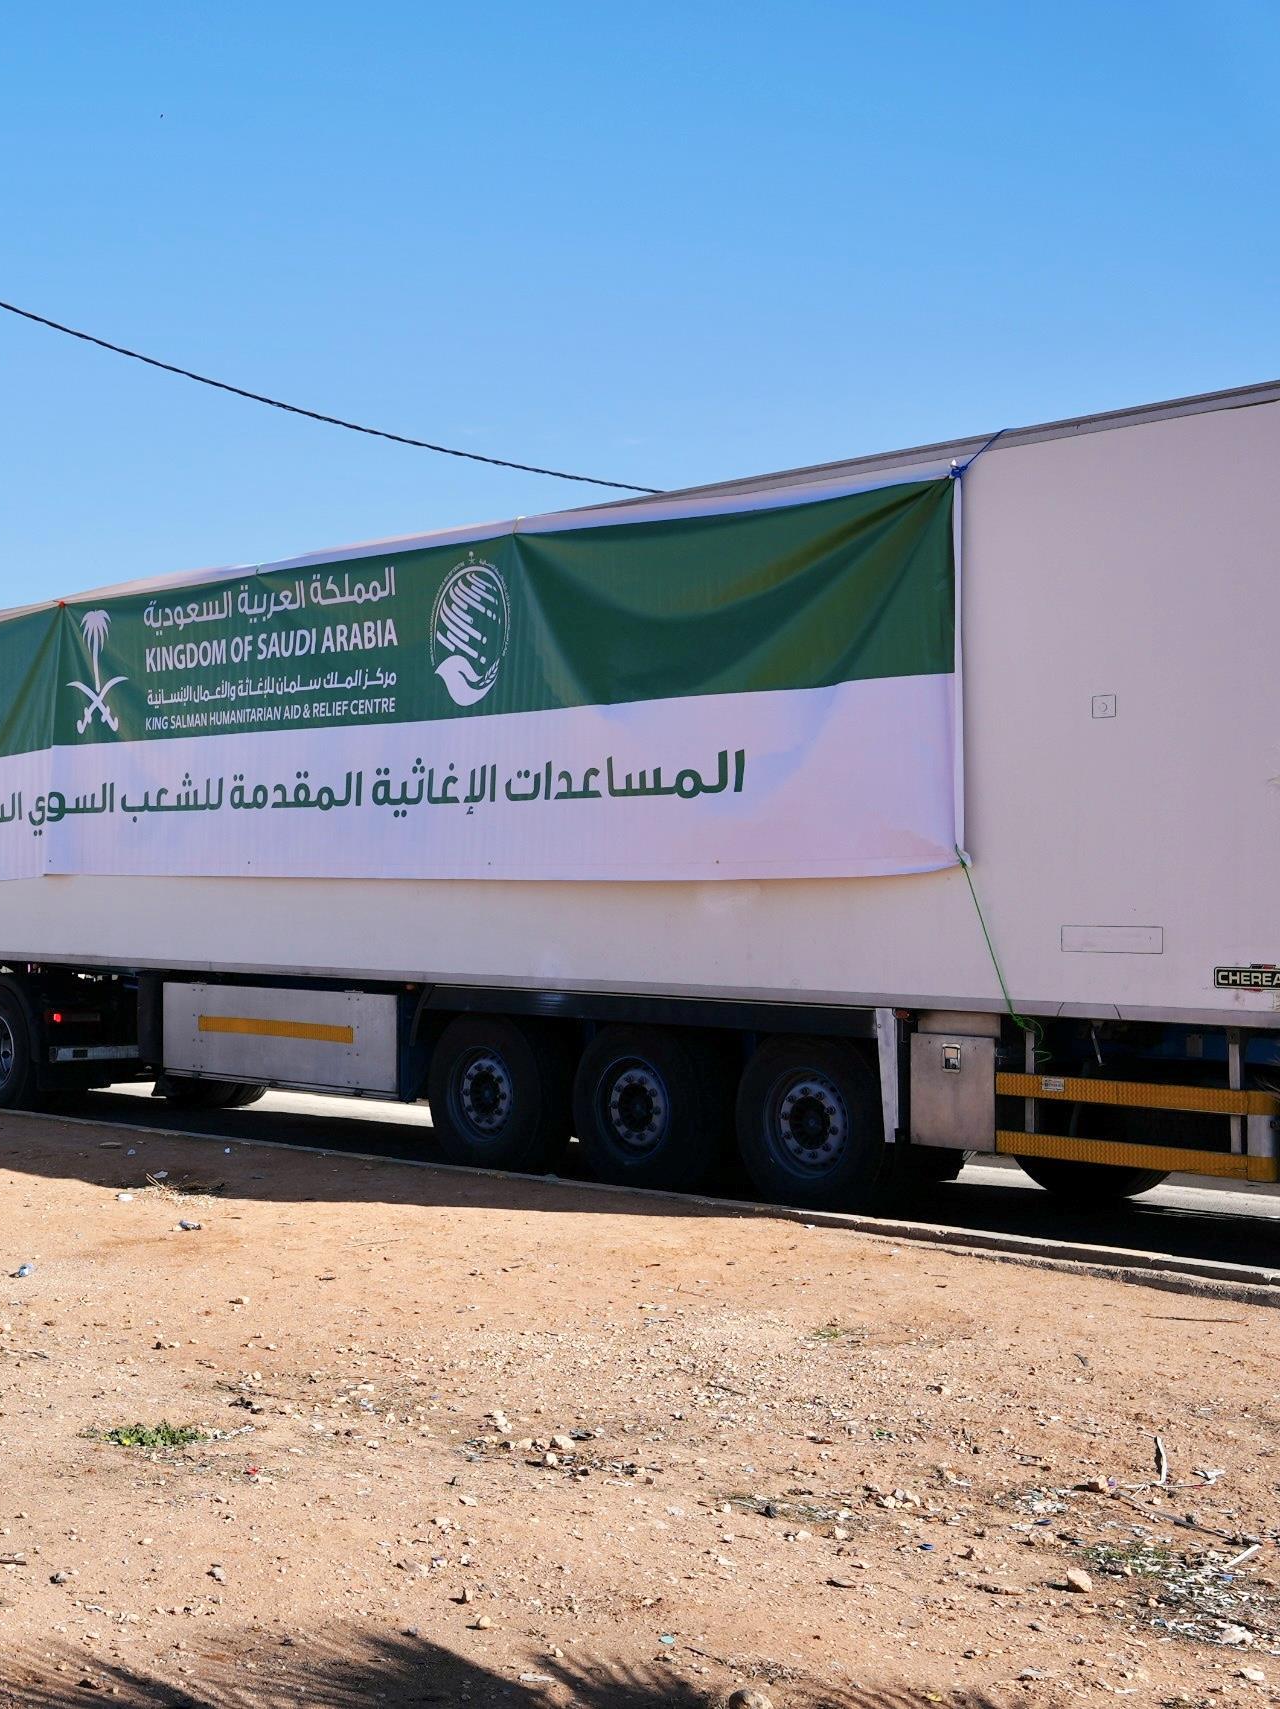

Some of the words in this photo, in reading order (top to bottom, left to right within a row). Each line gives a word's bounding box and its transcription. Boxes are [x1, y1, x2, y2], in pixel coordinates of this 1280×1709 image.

[237, 580, 306, 624] العربية
[310, 566, 396, 605] المملكة
[143, 590, 232, 636] السعودية
[145, 638, 227, 673] KINGDOM
[230, 635, 253, 664] OF
[257, 628, 317, 661] SAUDI
[320, 618, 399, 654] ARABIA
[147, 685, 193, 709] الإنسانية
[193, 679, 236, 703] والأعمال
[237, 676, 275, 699] للإغاثة
[276, 674, 322, 695] سلمان
[323, 669, 362, 690] الملك
[362, 667, 397, 690] مركز
[145, 717, 169, 731] KING
[170, 713, 208, 730] SALMAN
[209, 706, 282, 726] HUMANITARIAN
[283, 704, 302, 720] AID
[303, 703, 311, 718] &
[312, 700, 349, 718] RELIEF
[350, 697, 396, 715] CENTRE
[229, 769, 363, 811] المقدمة
[371, 757, 497, 818] الإغاثية
[505, 748, 746, 801] المساعدات
[120, 772, 223, 823] للشعب
